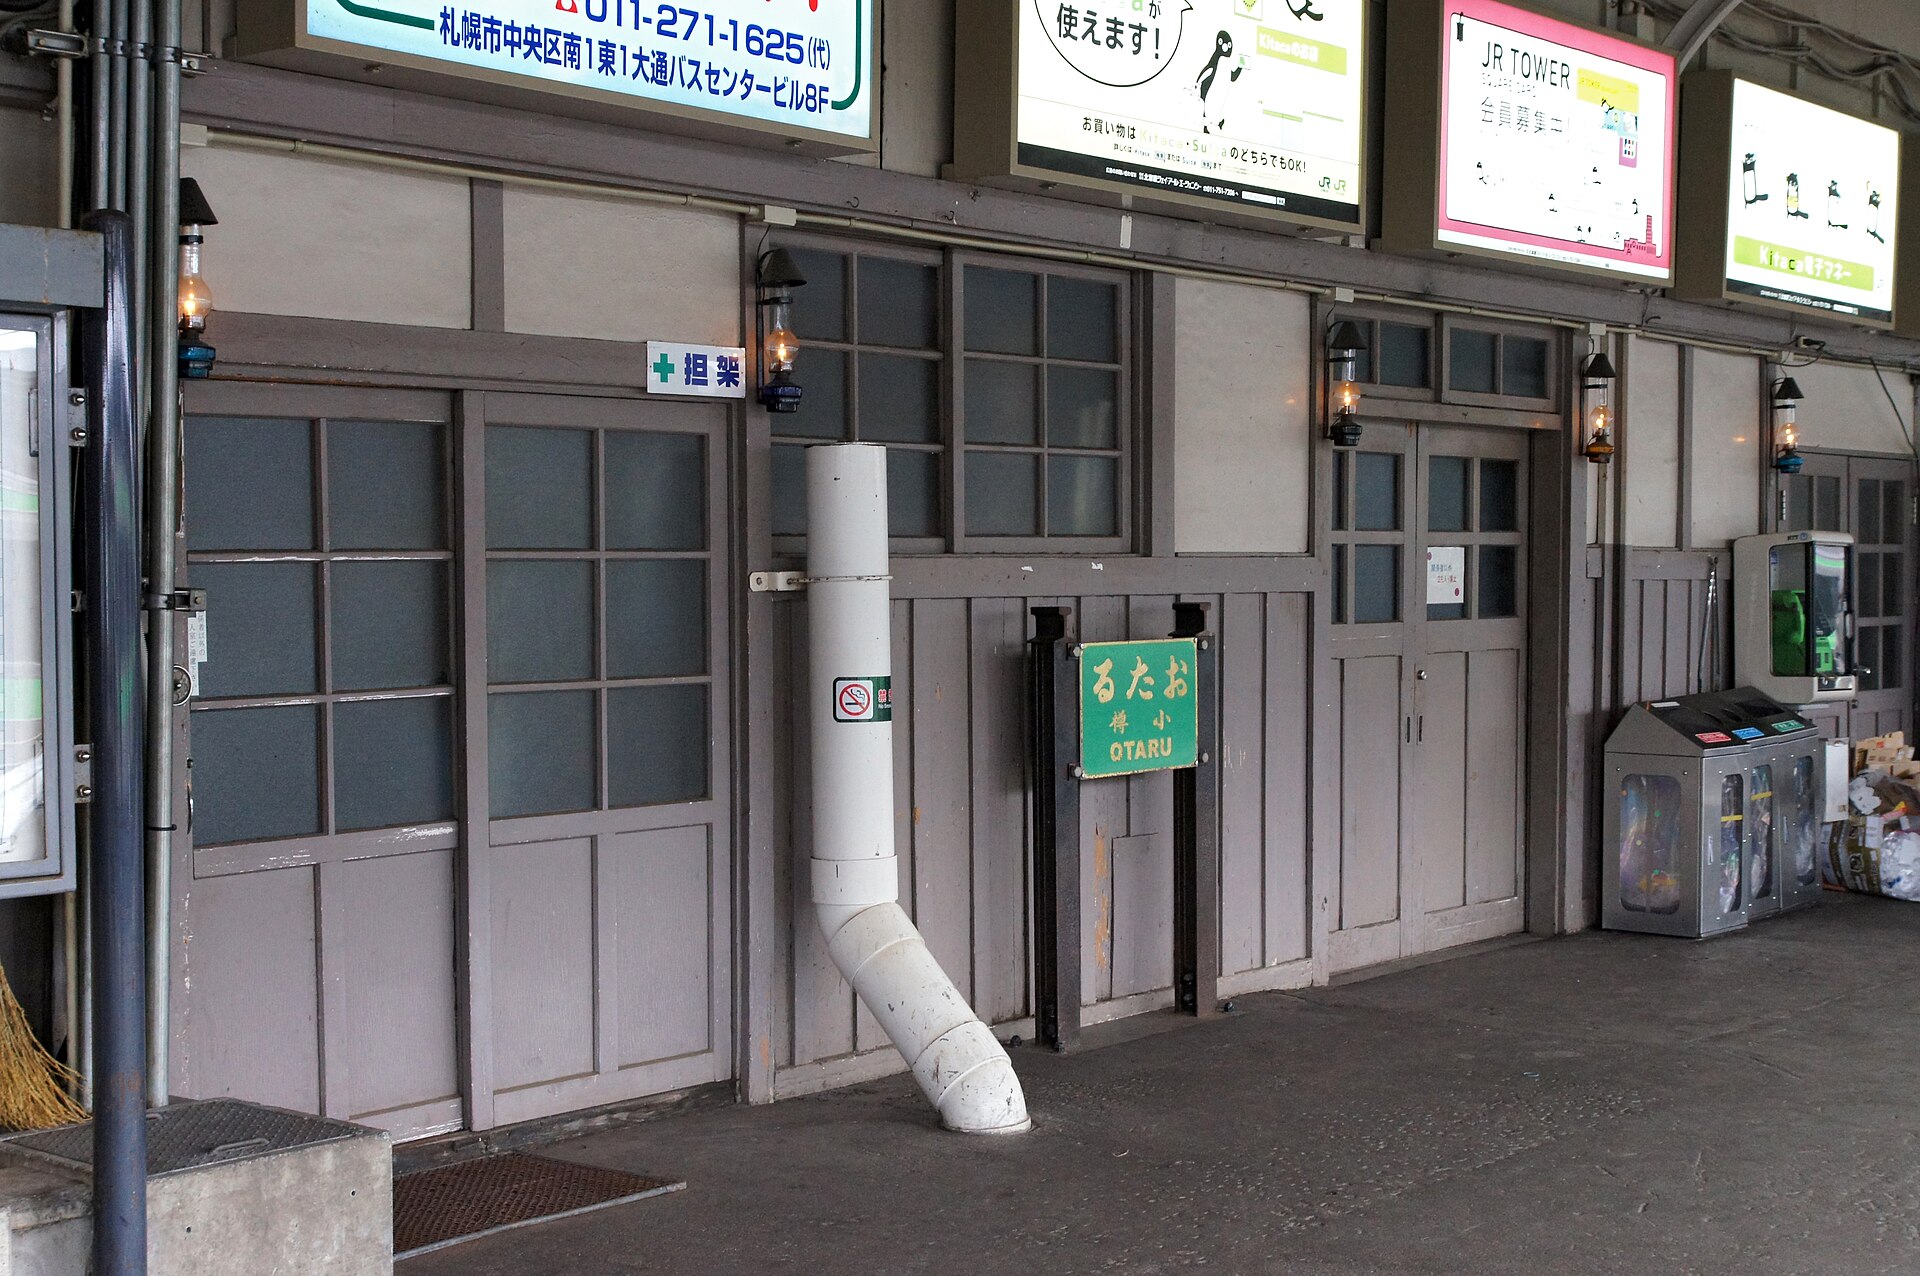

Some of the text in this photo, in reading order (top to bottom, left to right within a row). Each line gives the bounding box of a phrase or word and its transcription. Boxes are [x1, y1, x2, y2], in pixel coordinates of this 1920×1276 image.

[1057, 3, 1159, 59] 使えます!
[440, 6, 829, 113] 札幌市中央区南1東1大通バスセンタービル8F
[1481, 41, 1503, 71] JR
[1510, 48, 1570, 90] TOWER
[1318, 176, 1331, 189] JR
[684, 353, 740, 387] 担架
[1110, 737, 1172, 762] OTARU
